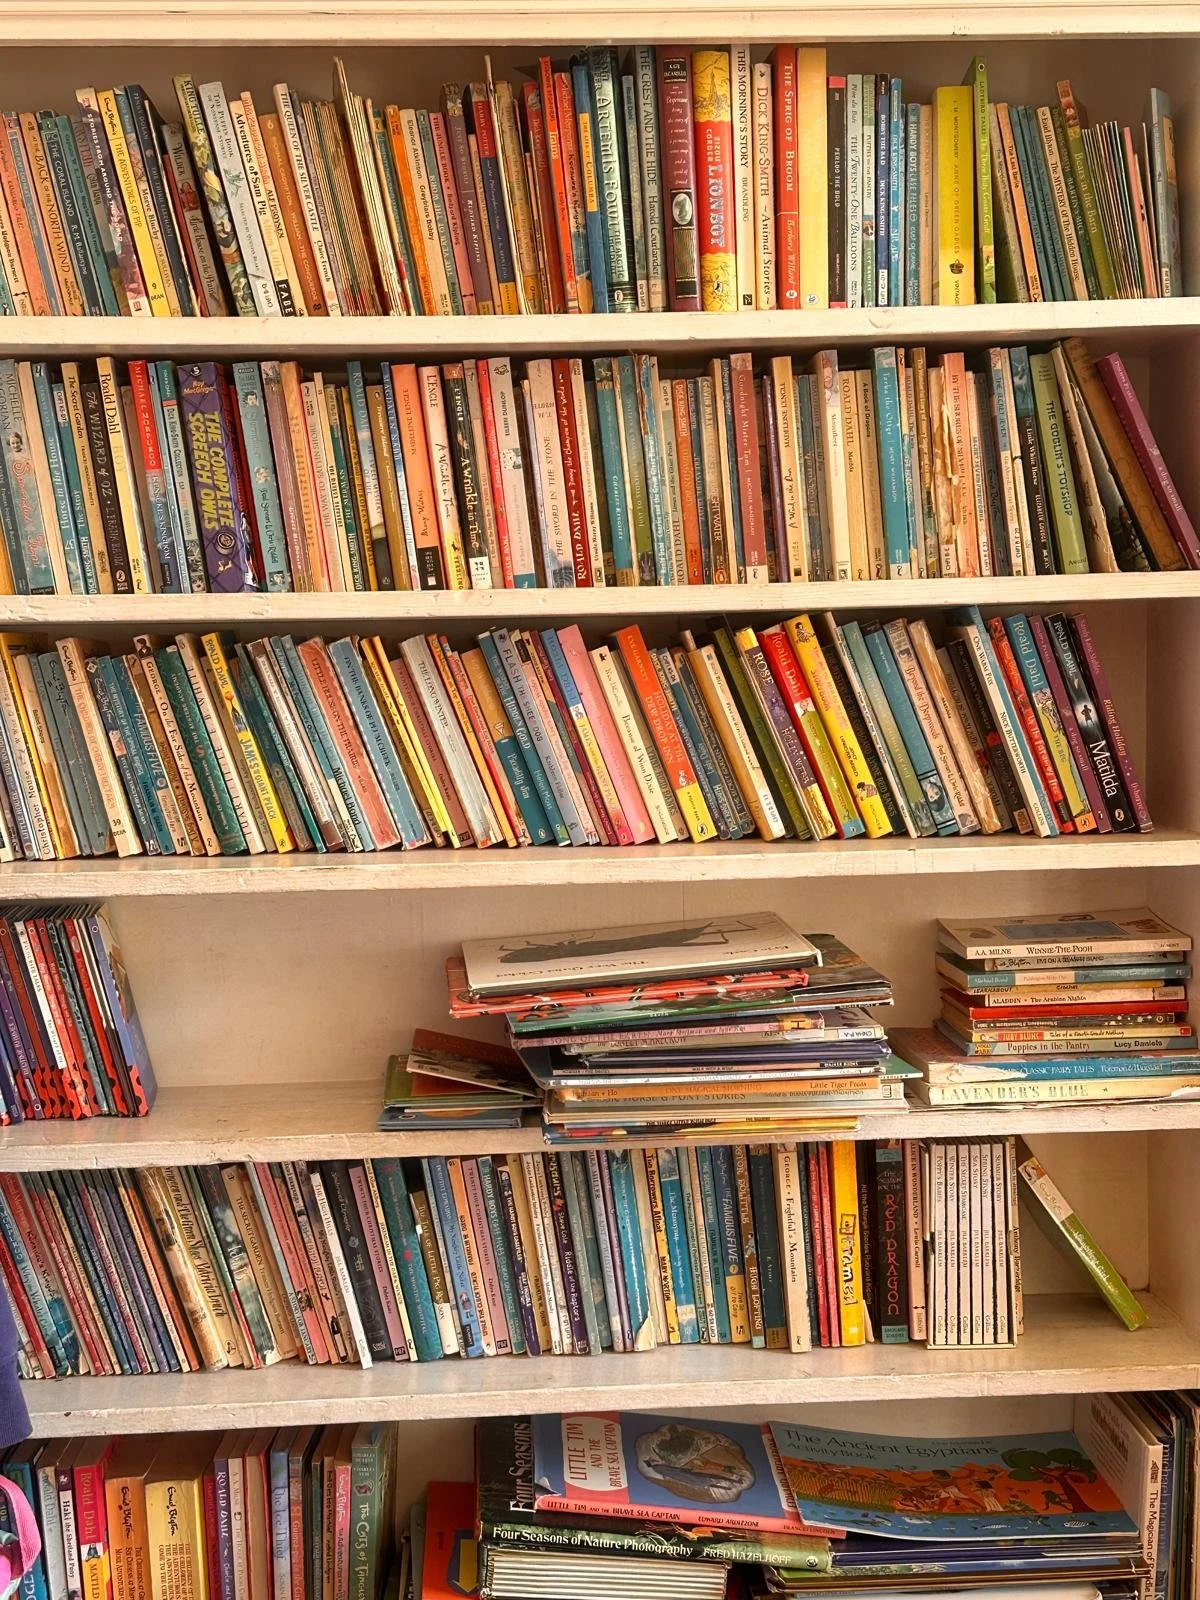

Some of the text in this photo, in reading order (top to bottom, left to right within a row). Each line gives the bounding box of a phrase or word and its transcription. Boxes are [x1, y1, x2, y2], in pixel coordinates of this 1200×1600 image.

[476, 102, 490, 156] HARRY POTTER
[639, 49, 657, 186] THE CREST AND THE HIDE
[706, 128, 714, 162] CORDER
[738, 49, 750, 222] THIS MORNING'S STORY BRANDLING
[756, 87, 772, 197] DICK KING-SMITH
[784, 63, 796, 191] THE SPRIG OF BROOM
[86, 113, 123, 242] STORIES FROM AROUND THE WORLD
[115, 142, 143, 228] THE ADVENTURES OF PIP
[234, 112, 269, 216] Adventures of Sam Pig
[280, 92, 319, 232] THE QUEEN OF THE SILVER CASTLE
[595, 96, 622, 228] ARTEMIS FOWL
[1074, 152, 1099, 233] Bears in the Barn
[34, 155, 71, 273] BACK NORTH WIND
[649, 195, 663, 276] Harold Courlander
[707, 164, 725, 248] LIONBOY
[850, 135, 861, 271] THE TWENTY-ONE BALLOONS
[786, 219, 797, 284] Barbara Willard
[100, 373, 120, 435] Roald Dahl
[455, 388, 464, 421] L'ENGLE
[737, 375, 751, 466] Goodnight Mister Tom
[90, 413, 112, 497] WIZARD of OZ
[188, 412, 219, 531] SCREECH OWLS
[204, 411, 235, 528] THE COMPLETE
[1046, 401, 1073, 516] THE GOBLIN'S TOYSHOP
[460, 457, 480, 549] A Wrinkle in Time
[543, 436, 564, 557] THE SWORD IN THE STONE
[146, 661, 161, 695] GEORGE
[771, 635, 803, 697] Roald Dahl
[1012, 621, 1042, 688] Roald Dahl
[1053, 621, 1119, 798] ROALD DAHL Matilda
[1102, 699, 1128, 756] Riding Holiday
[999, 712, 1026, 774] NICK BUTTERWORTH
[332, 767, 362, 826] Michael Bond
[1007, 1042, 1090, 1053] Puppies in the Pantry
[1114, 1039, 1163, 1049] Lucy Daniels
[810, 1081, 847, 1089] Little Tiger
[940, 1084, 1089, 1102] LAVENDER'S BLUE
[647, 1168, 663, 1233] Borrowers Afloat
[783, 1156, 798, 1283] GEORGE Frightful's Mountain
[911, 1172, 919, 1219] WONDERLAND
[722, 1198, 739, 1263] FAMOUS FIVE
[884, 1194, 901, 1316] RED DRAGON
[564, 1251, 582, 1322] Riddle Raptors
[508, 1423, 534, 1475] Seasons
[566, 1423, 588, 1480] LITTLE TIM
[785, 1430, 1001, 1458] The Ancient Egyptians
[62, 1500, 72, 1521] Haki
[80, 1472, 96, 1539] Roald Dahl
[167, 1486, 178, 1536] Enid Blyton
[217, 1471, 230, 1539] ROALD DAHL
[547, 1501, 681, 1521] LITTLE TIM BRAVE SEA CAPTAIN
[698, 1516, 760, 1528] EDWARD ARDIZZONE
[1146, 1490, 1159, 1550] The Magician
[65, 1534, 74, 1562] Shetland
[493, 1528, 694, 1557] Four Seasons of Nature Photography
[703, 1547, 792, 1565] FRED HAZELHOFF
